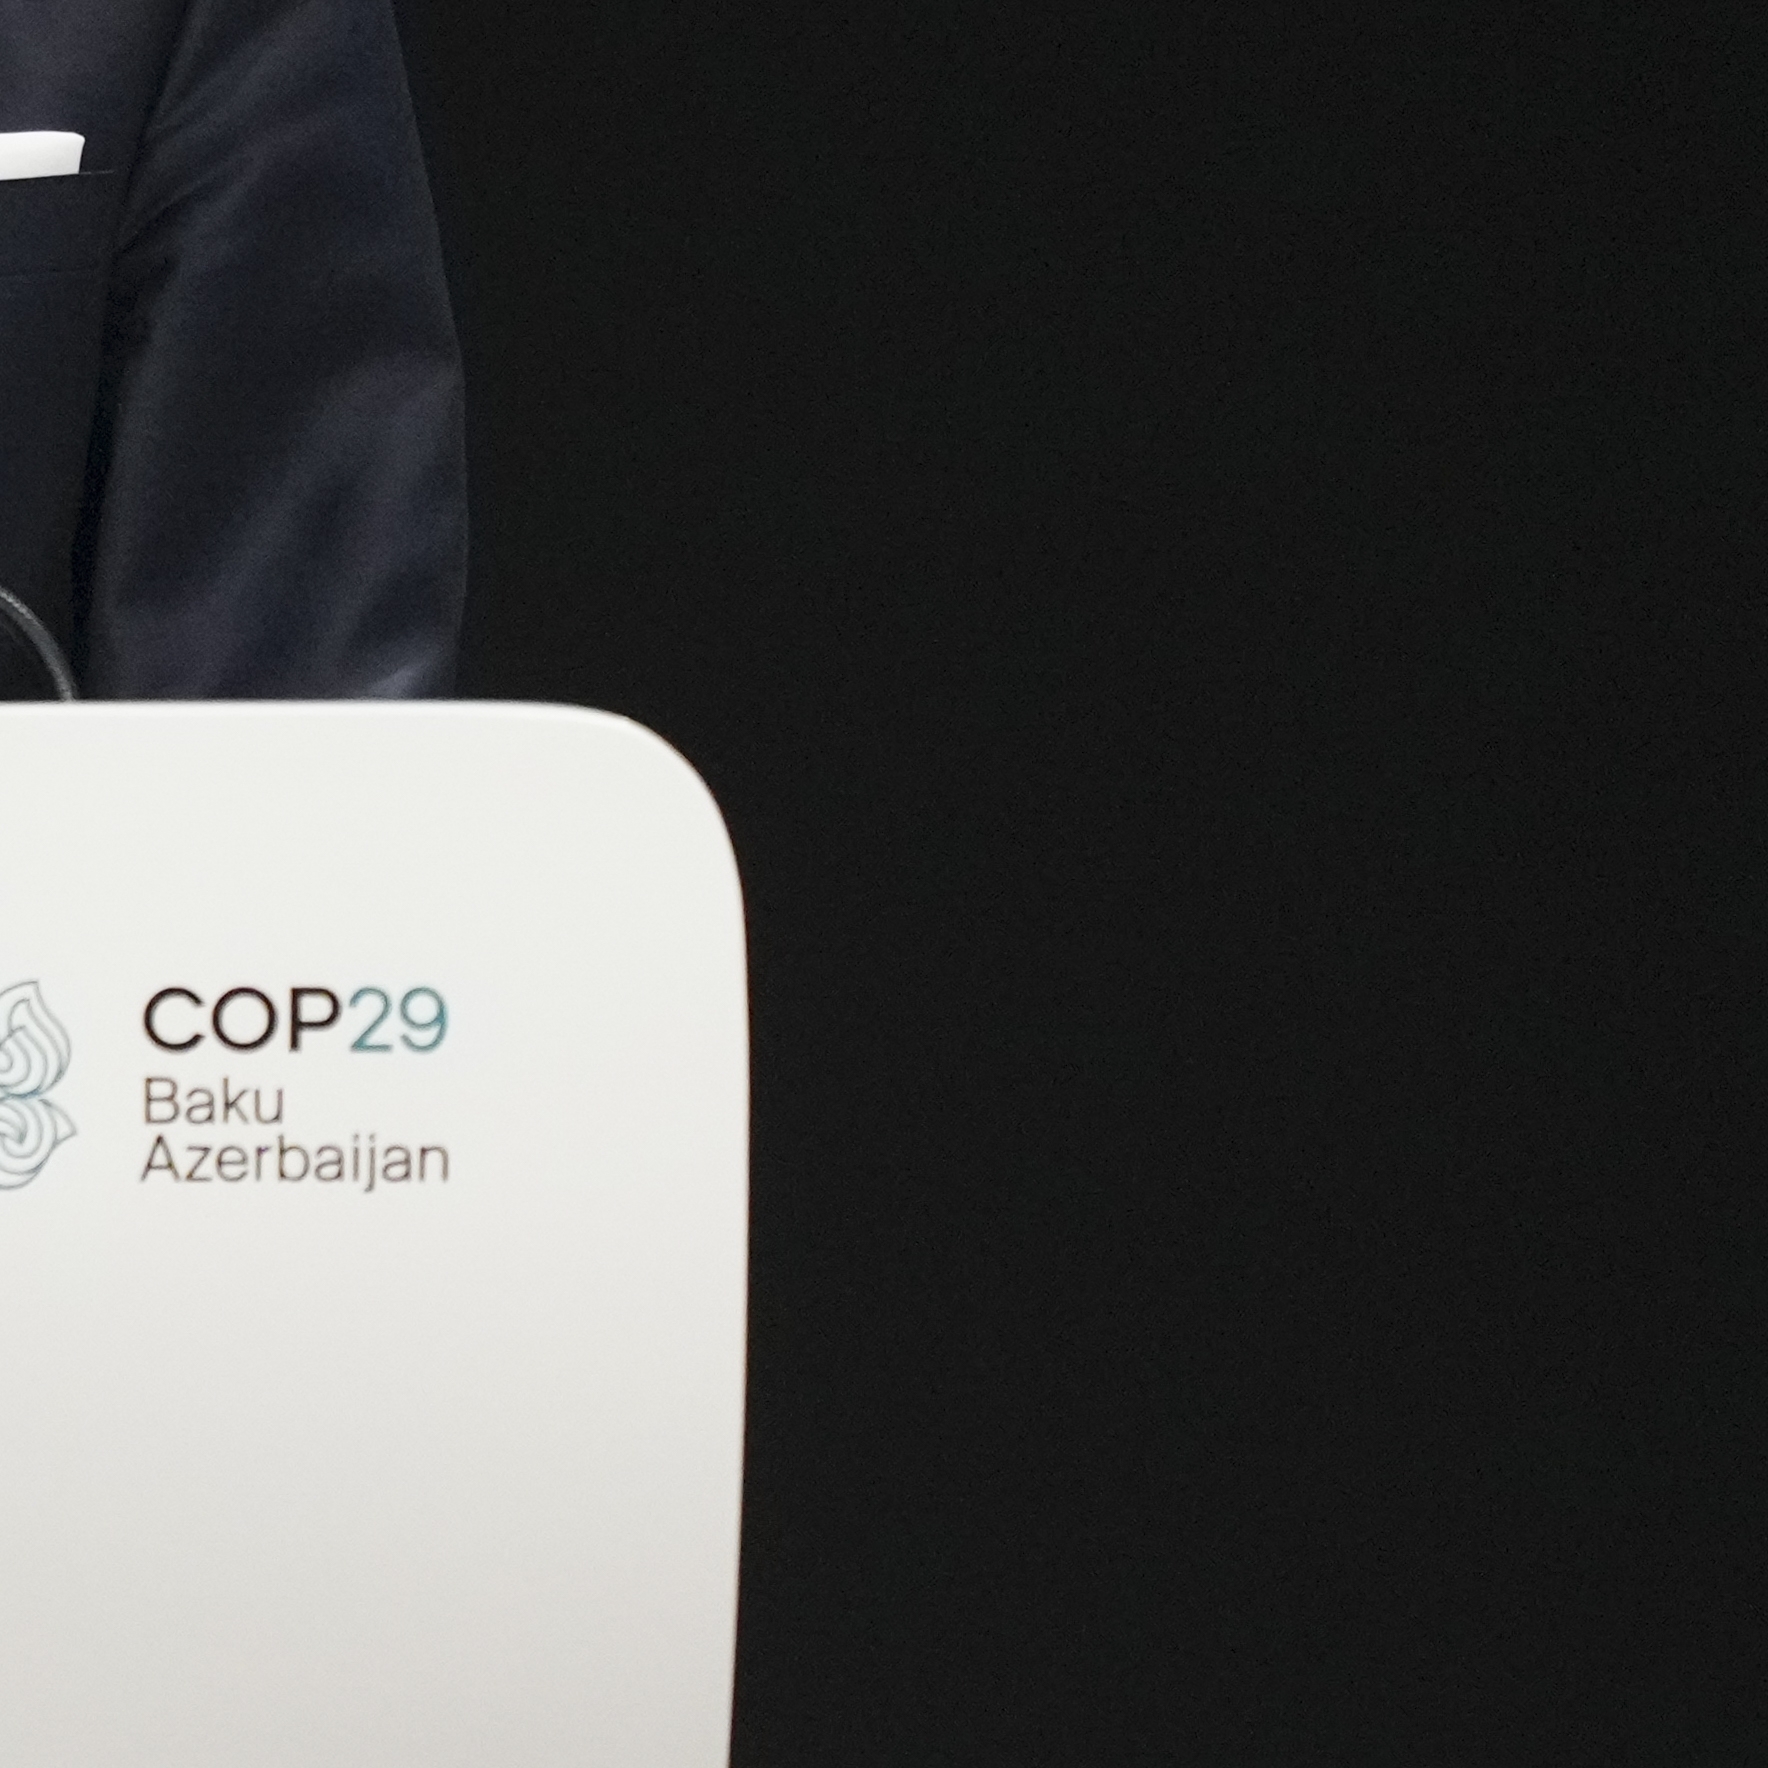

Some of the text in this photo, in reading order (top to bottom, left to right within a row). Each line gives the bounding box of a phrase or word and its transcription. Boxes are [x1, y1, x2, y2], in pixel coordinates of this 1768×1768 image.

[141, 985, 451, 1056] COP29
[143, 1076, 285, 1126] Baku
[140, 1134, 451, 1194] Azerbaijan
